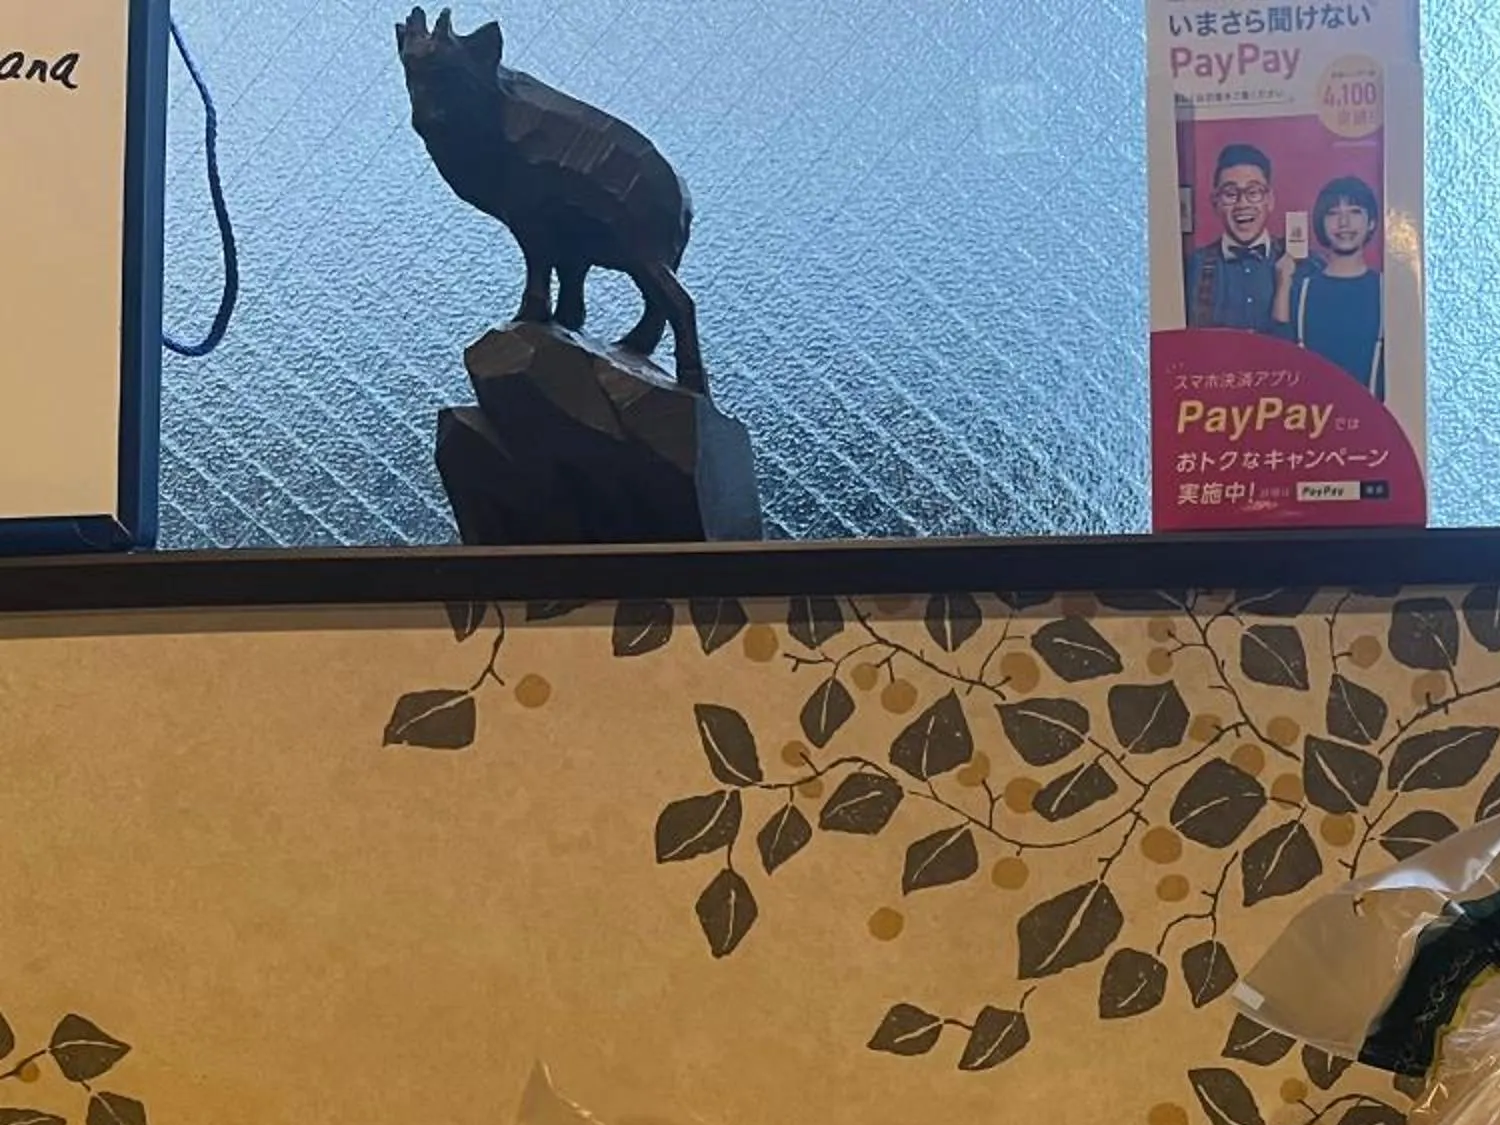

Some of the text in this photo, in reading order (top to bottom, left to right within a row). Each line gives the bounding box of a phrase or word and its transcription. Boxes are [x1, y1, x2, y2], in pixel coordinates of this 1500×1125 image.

[1168, 5, 1372, 37] いまさら聞けない
[1169, 42, 1302, 84] PayPay
[1173, 369, 1302, 391] スマホ決済アプリ
[1177, 397, 1334, 442] PayPay
[1176, 448, 1389, 473] おトクなキャンペーン
